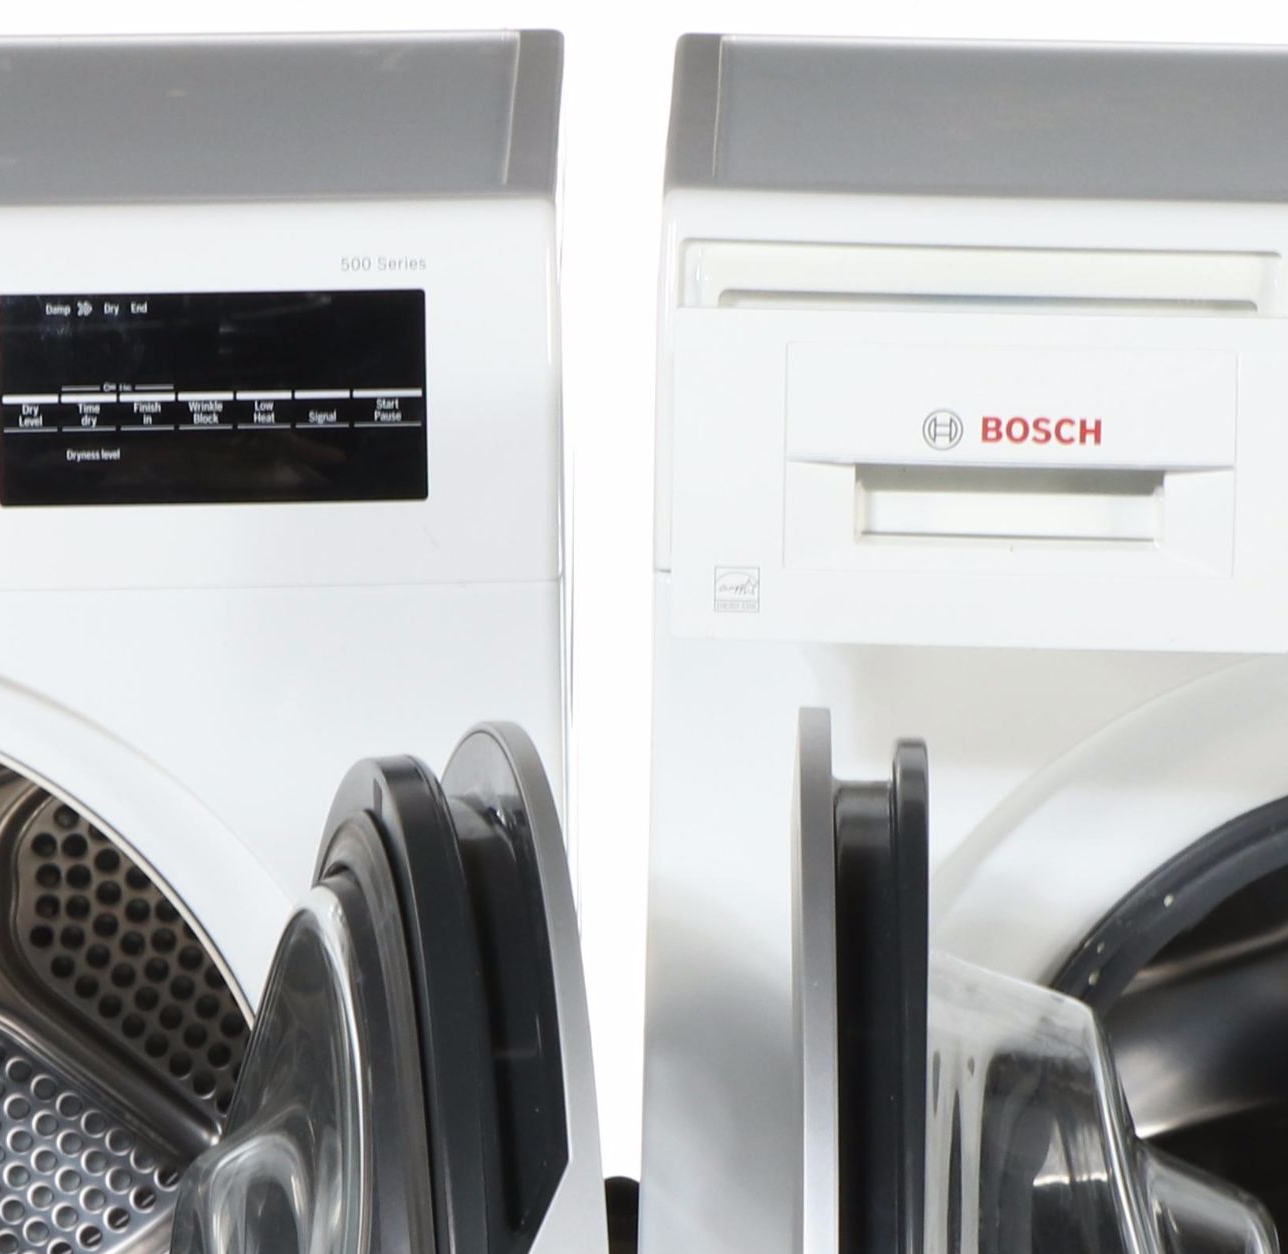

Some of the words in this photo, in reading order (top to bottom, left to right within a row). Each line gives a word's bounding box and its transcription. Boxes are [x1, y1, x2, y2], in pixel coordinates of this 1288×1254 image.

[341, 256, 371, 272] 500
[378, 256, 426, 270] Series
[46, 304, 71, 316] Damp
[104, 303, 119, 315] Dry
[131, 302, 147, 313] End
[22, 403, 40, 416] Dry
[78, 403, 101, 415] Time
[133, 401, 162, 413] Finish
[189, 401, 223, 413] Wrinkle
[255, 400, 273, 412] Low
[376, 398, 399, 411] Start
[19, 416, 43, 428] Level
[81, 415, 98, 428] dry
[194, 413, 218, 424] Block
[254, 412, 274, 423] Heat
[308, 411, 337, 425] Signal
[374, 411, 402, 422] Pause
[981, 416, 1101, 445] BOSCH
[67, 450, 100, 462] Dryness
[101, 449, 120, 460] level
